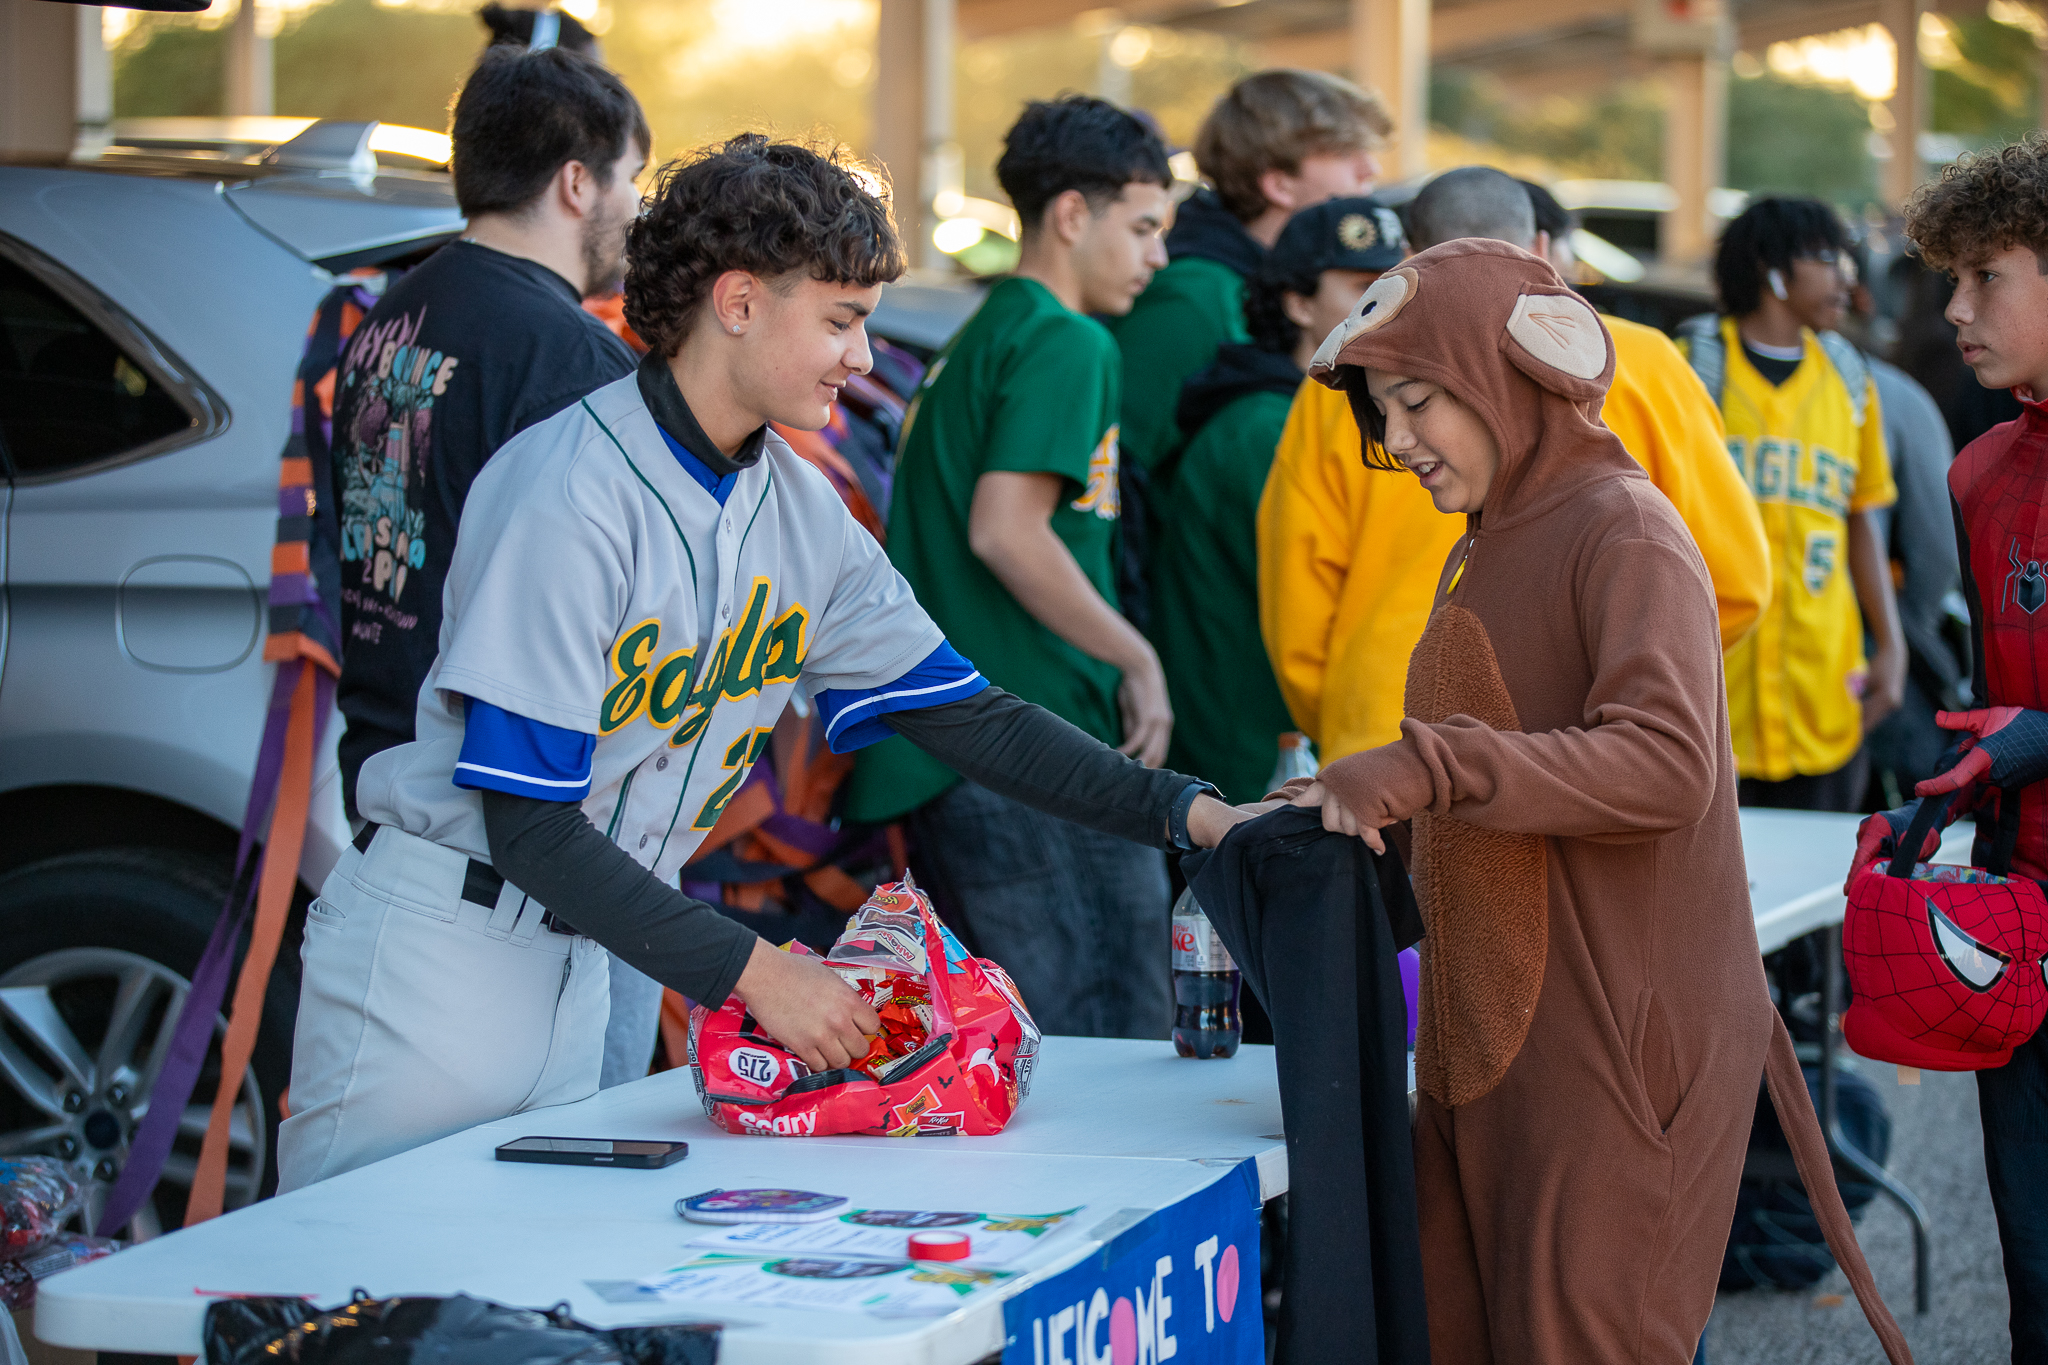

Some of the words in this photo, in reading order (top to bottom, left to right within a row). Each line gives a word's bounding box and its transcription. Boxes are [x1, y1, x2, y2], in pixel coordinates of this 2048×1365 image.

[599, 575, 815, 748] Eagles
[738, 1055, 771, 1082] 275
[738, 1111, 817, 1134] Scary
[1194, 1234, 1240, 1334] TO
